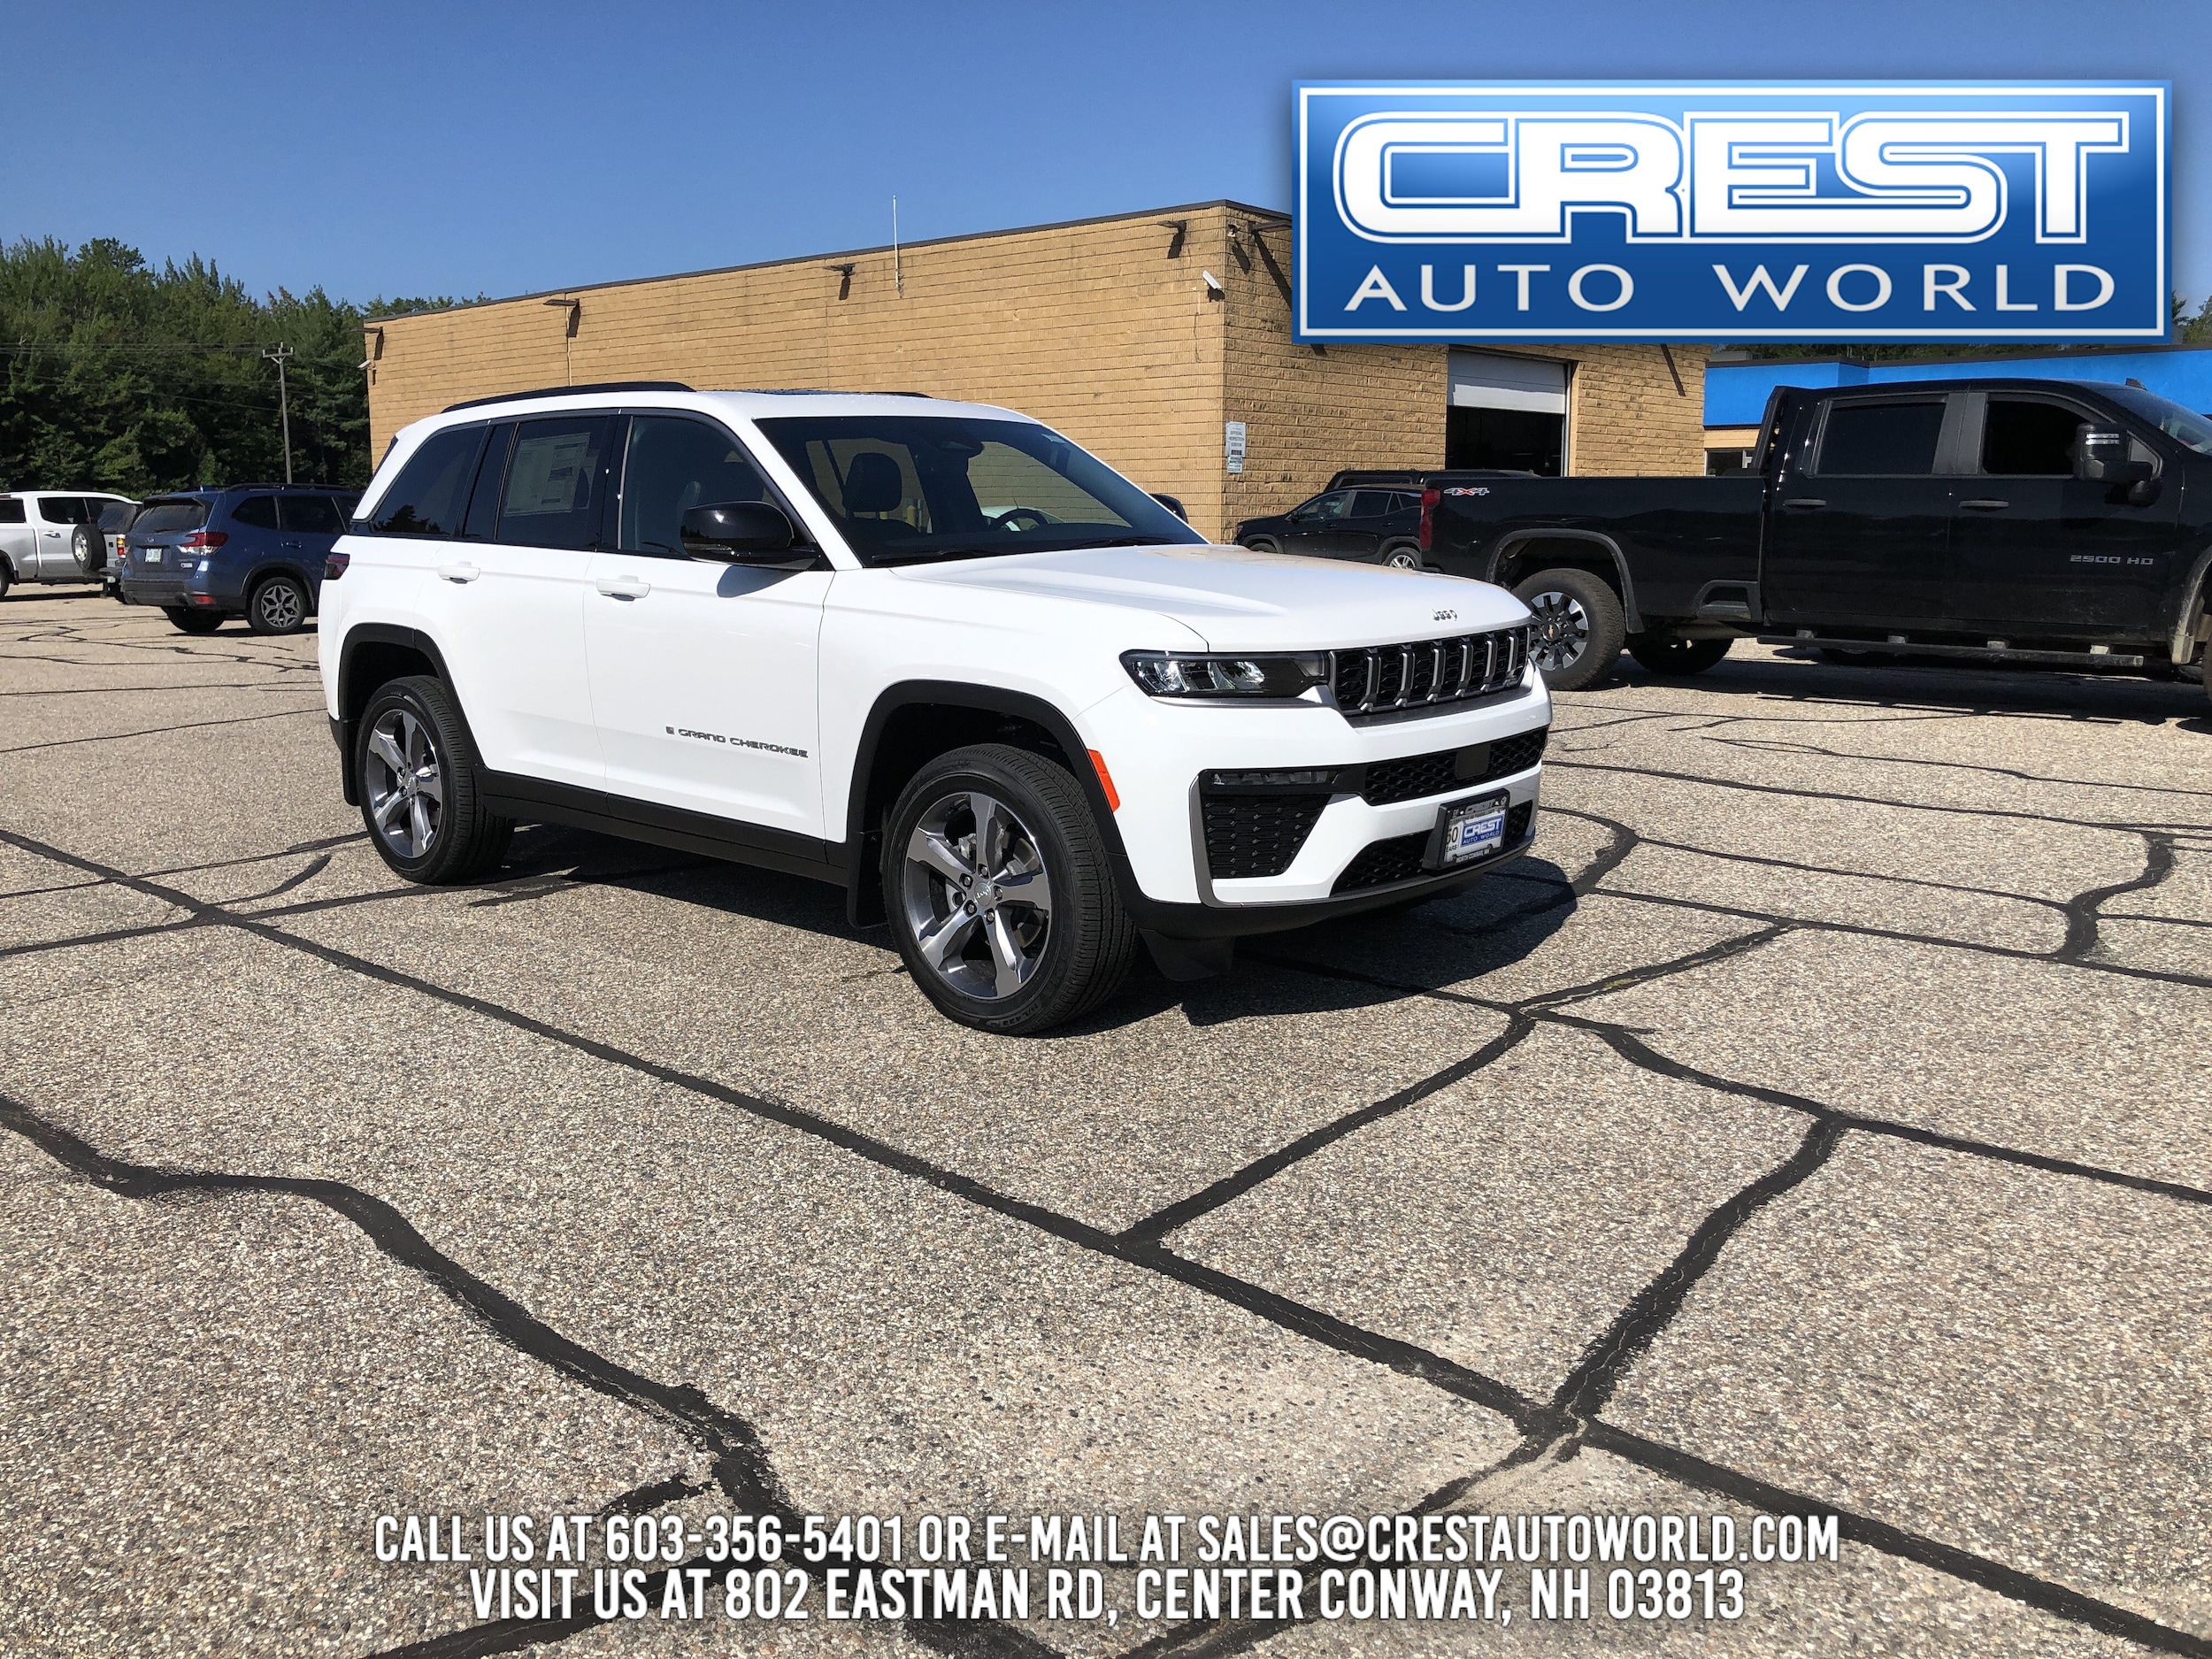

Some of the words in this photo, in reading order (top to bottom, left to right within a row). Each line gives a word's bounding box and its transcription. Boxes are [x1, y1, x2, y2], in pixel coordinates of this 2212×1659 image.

[2070, 555, 2121, 564] 2500
[2126, 557, 2154, 565] HD
[1430, 608, 1458, 621] Jeep
[678, 728, 726, 743] GRAND
[729, 737, 809, 758] CHEROKEE
[1463, 818, 1502, 838] CREST
[1463, 835, 1478, 844] AUTO
[1480, 830, 1500, 840] WORLD
